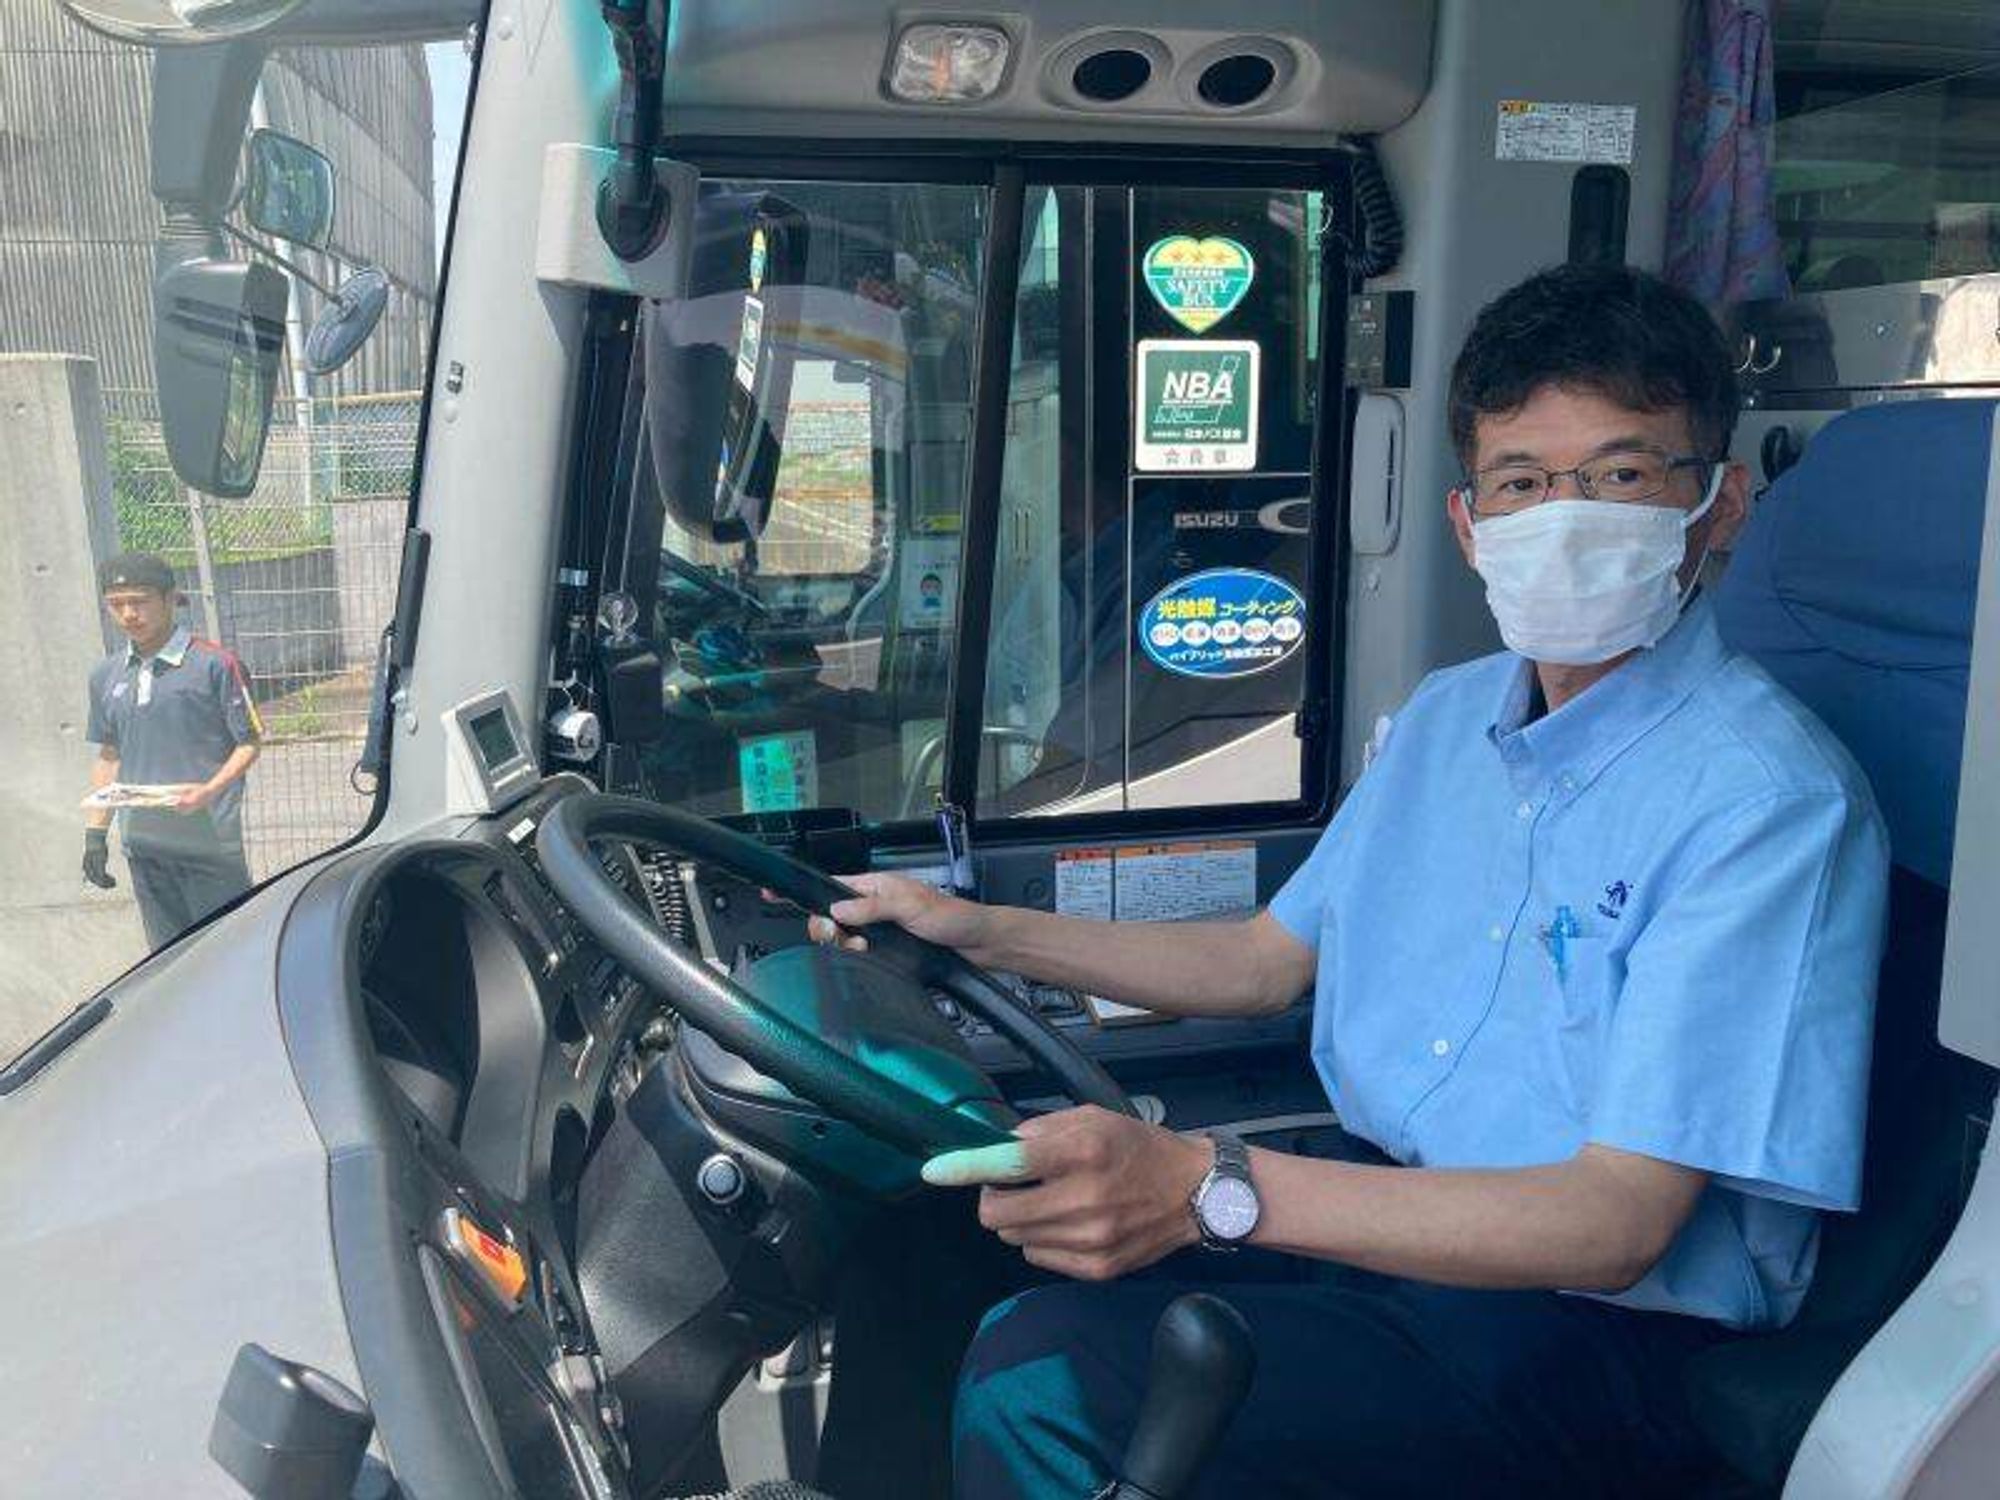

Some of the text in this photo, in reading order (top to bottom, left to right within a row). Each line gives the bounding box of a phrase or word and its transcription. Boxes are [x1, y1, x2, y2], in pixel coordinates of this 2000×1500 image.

[1166, 279, 1230, 294] SAFETY
[1162, 370, 1233, 399] NBA
[1174, 511, 1239, 528] ISUZU
